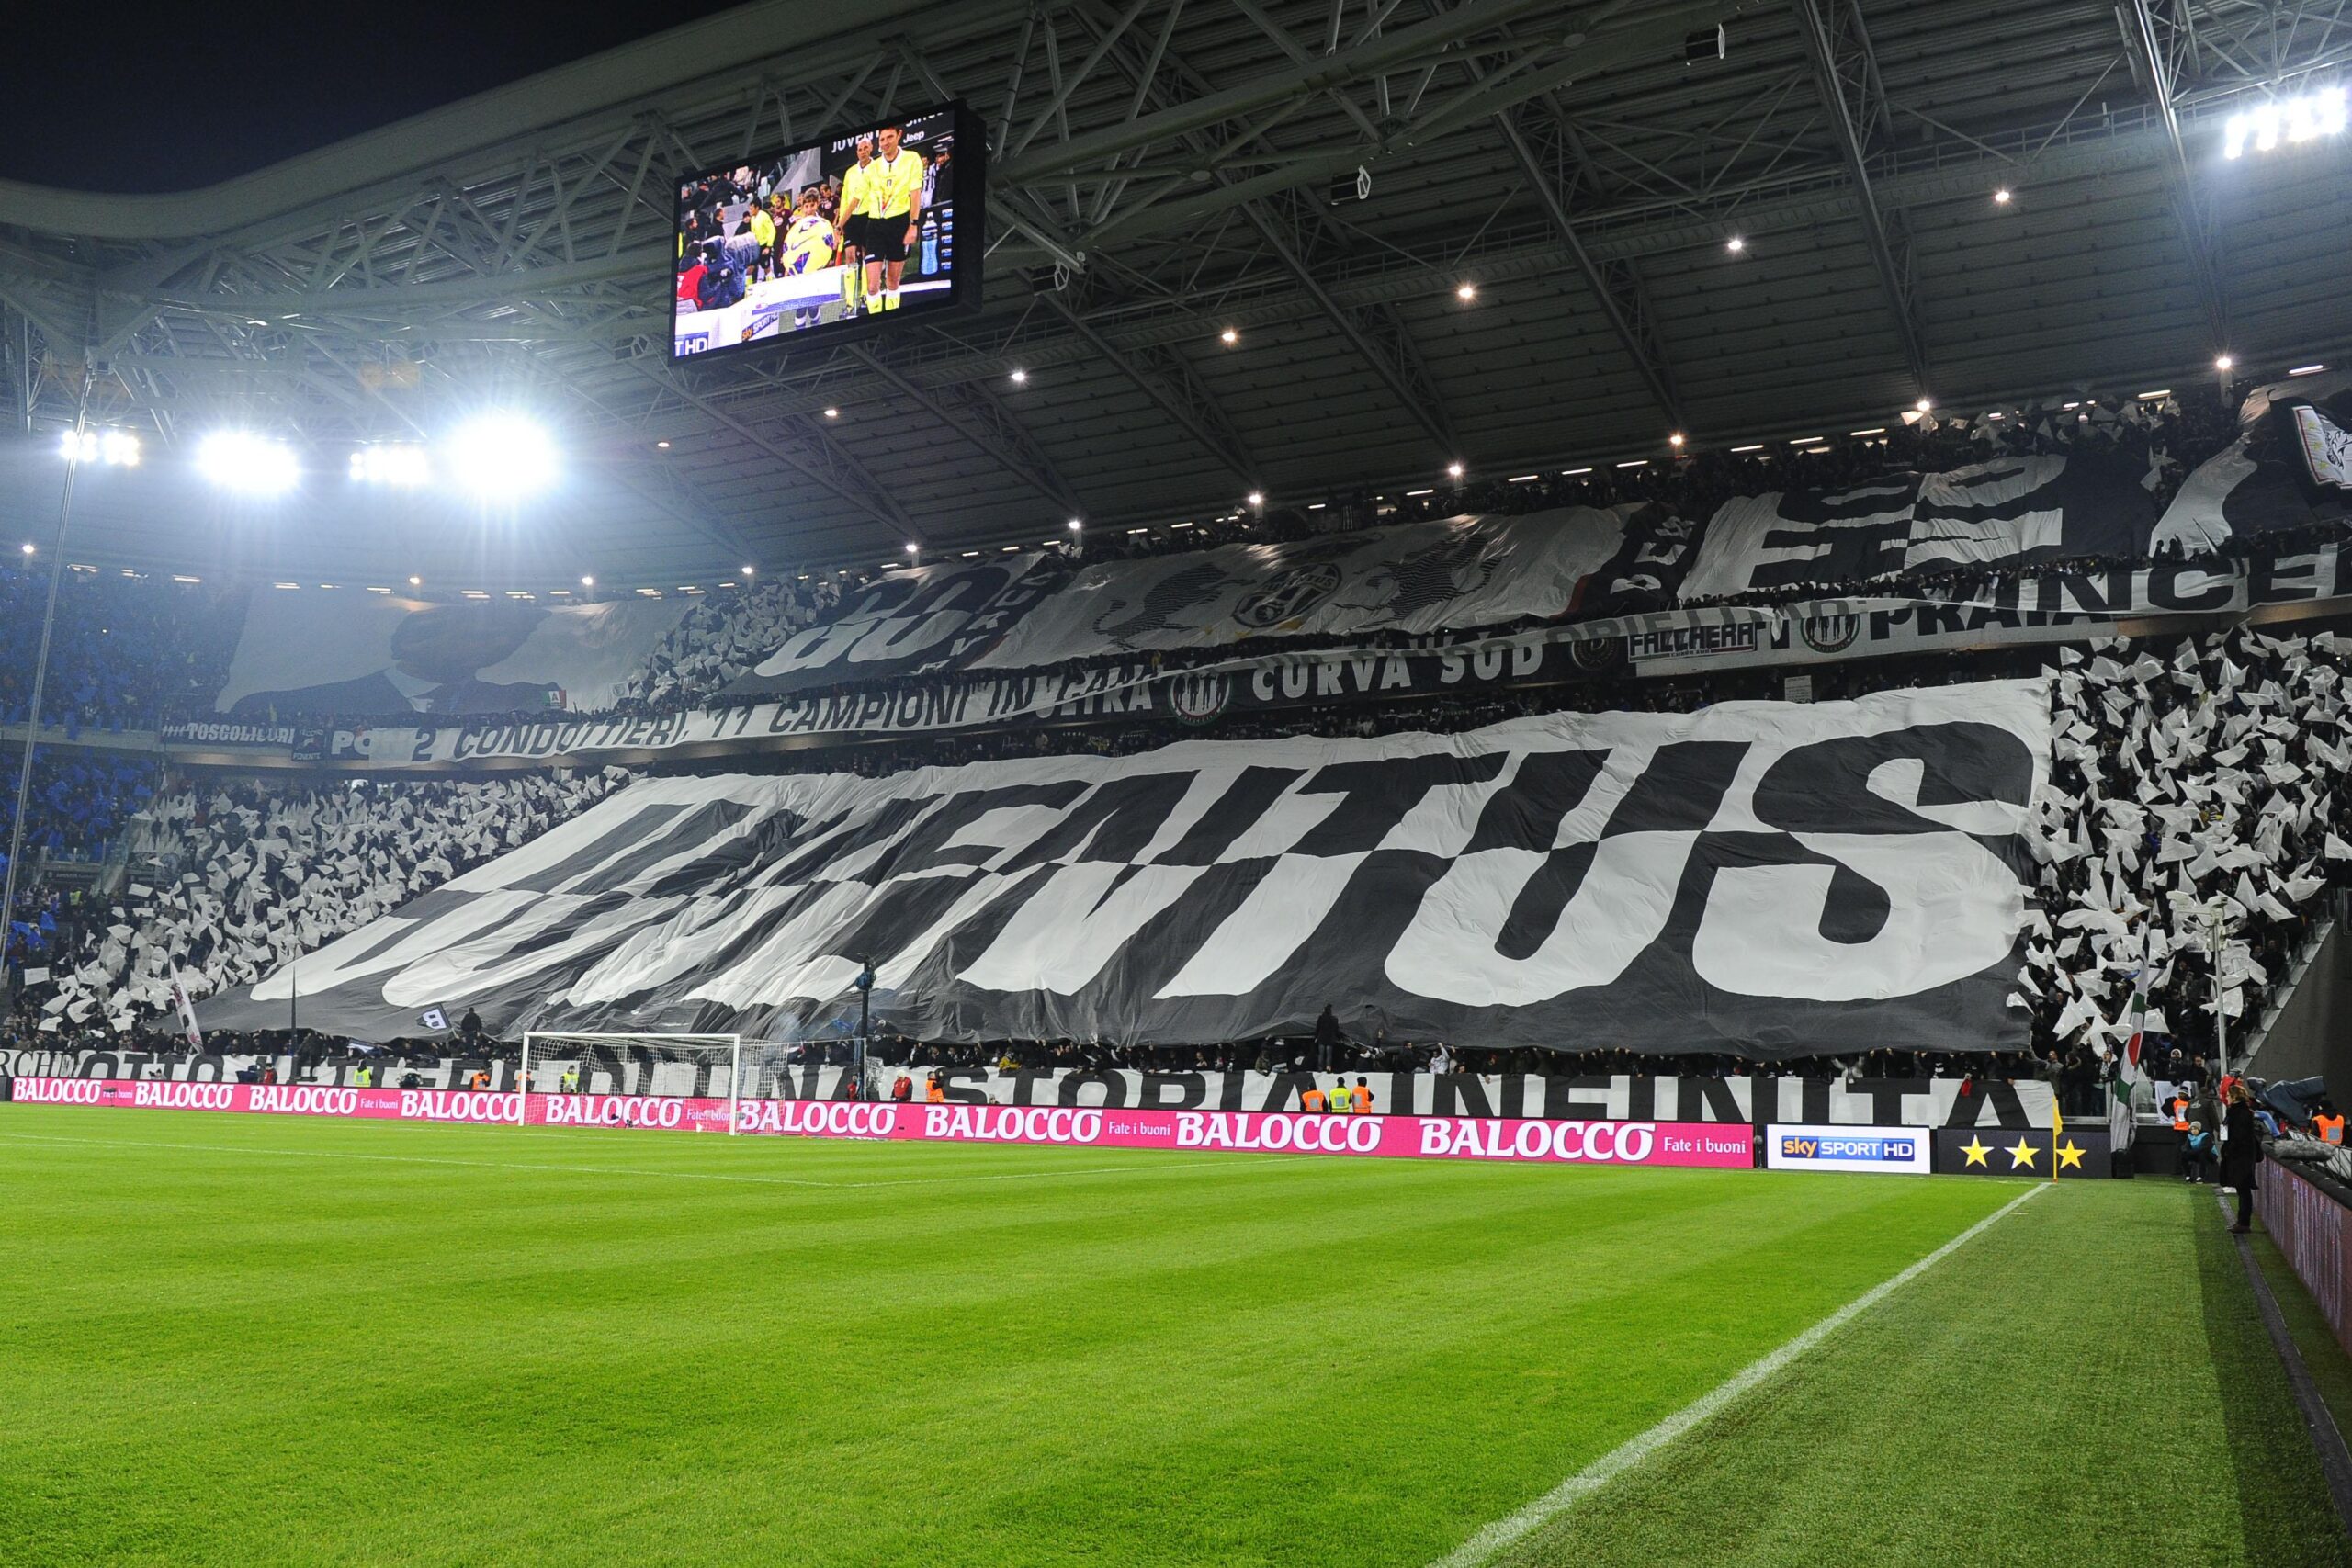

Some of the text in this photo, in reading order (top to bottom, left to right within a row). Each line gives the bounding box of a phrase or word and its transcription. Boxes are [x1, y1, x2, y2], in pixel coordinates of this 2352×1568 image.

[903, 130, 925, 143] Jeep
[684, 338, 707, 355] HD
[1252, 652, 1412, 702] CURVA
[1440, 643, 1544, 684] SUD
[411, 727, 437, 761] 2
[708, 705, 755, 738] 11
[769, 684, 970, 732] CAMPIONI
[250, 721, 2033, 1008] JUVENTUS
[13, 1077, 102, 1104] BALOCCO
[135, 1082, 234, 1110] BALOCCO
[249, 1085, 358, 1115] BALOCCO
[401, 1089, 522, 1122] BALOCCO
[1390, 1072, 2034, 1129] INFINITA
[546, 1095, 684, 1128] BALOCCO
[740, 1100, 897, 1136] BALOCCO
[924, 1105, 1103, 1144] BALOCCO
[1108, 1121, 1171, 1136] Fate i buoni
[1176, 1112, 1384, 1152] BALOCCO
[1419, 1118, 1656, 1162] BALOCCO
[1664, 1135, 1747, 1155] Fate i buoni
[1783, 1136, 1914, 1158] sky SPORT HD
